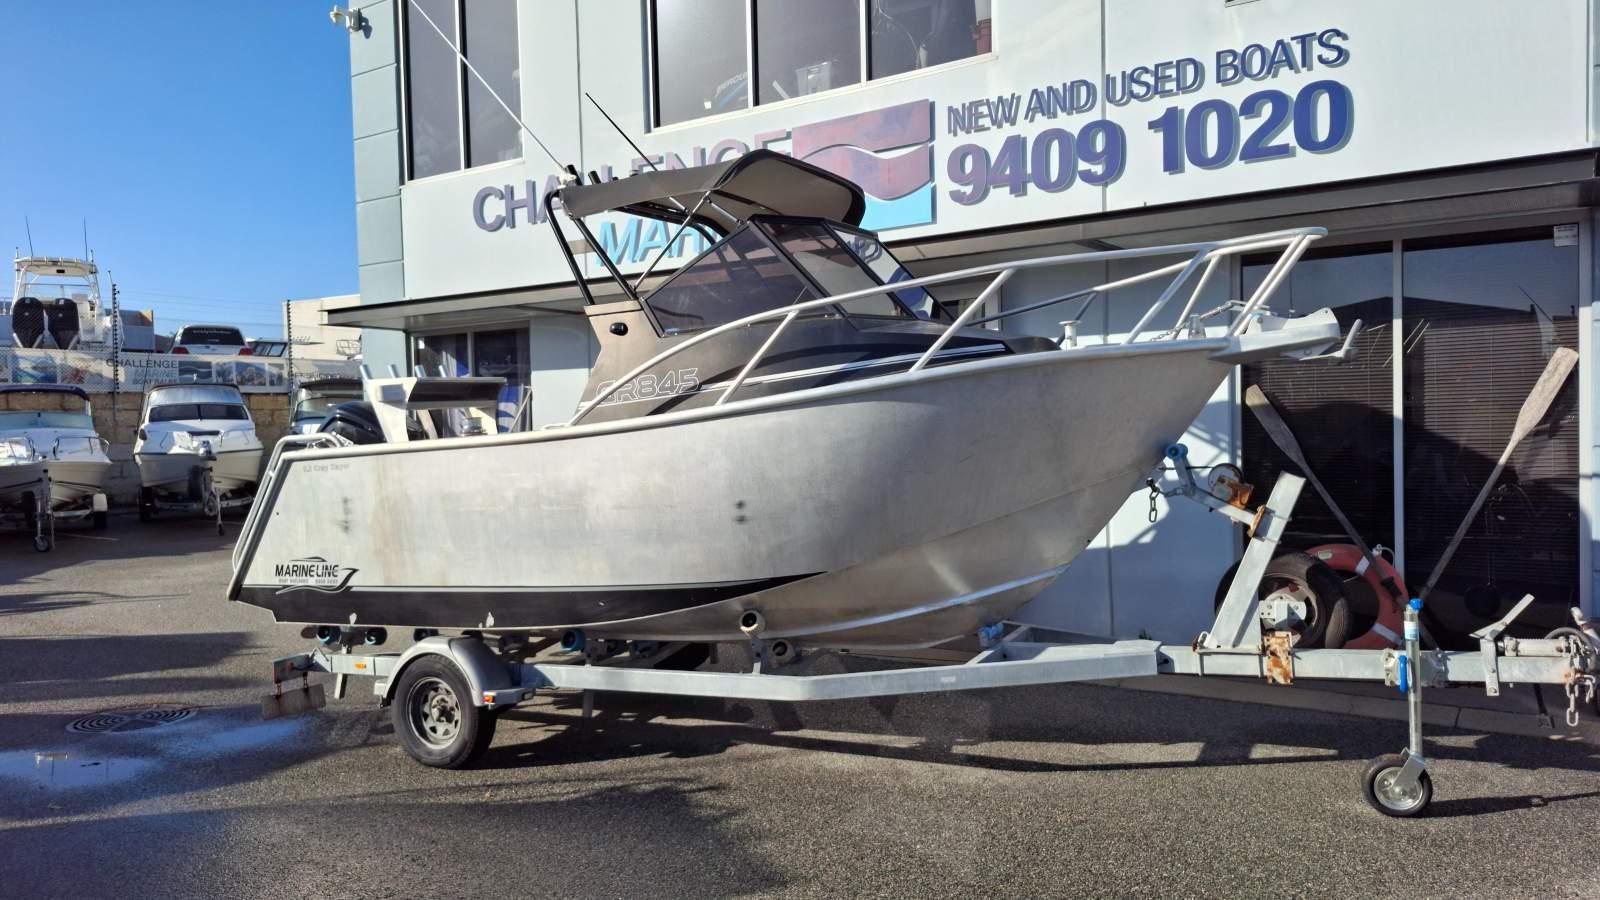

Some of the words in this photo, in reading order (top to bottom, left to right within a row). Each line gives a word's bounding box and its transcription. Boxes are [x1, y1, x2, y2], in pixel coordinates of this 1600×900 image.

[947, 92, 1021, 136] NEW
[1024, 80, 1097, 122] AND
[1105, 57, 1205, 107] USED
[1216, 28, 1350, 87] BOATS
[947, 119, 1127, 206] 9409
[1147, 79, 1355, 176] 1020
[275, 564, 339, 578] MARINELINE
